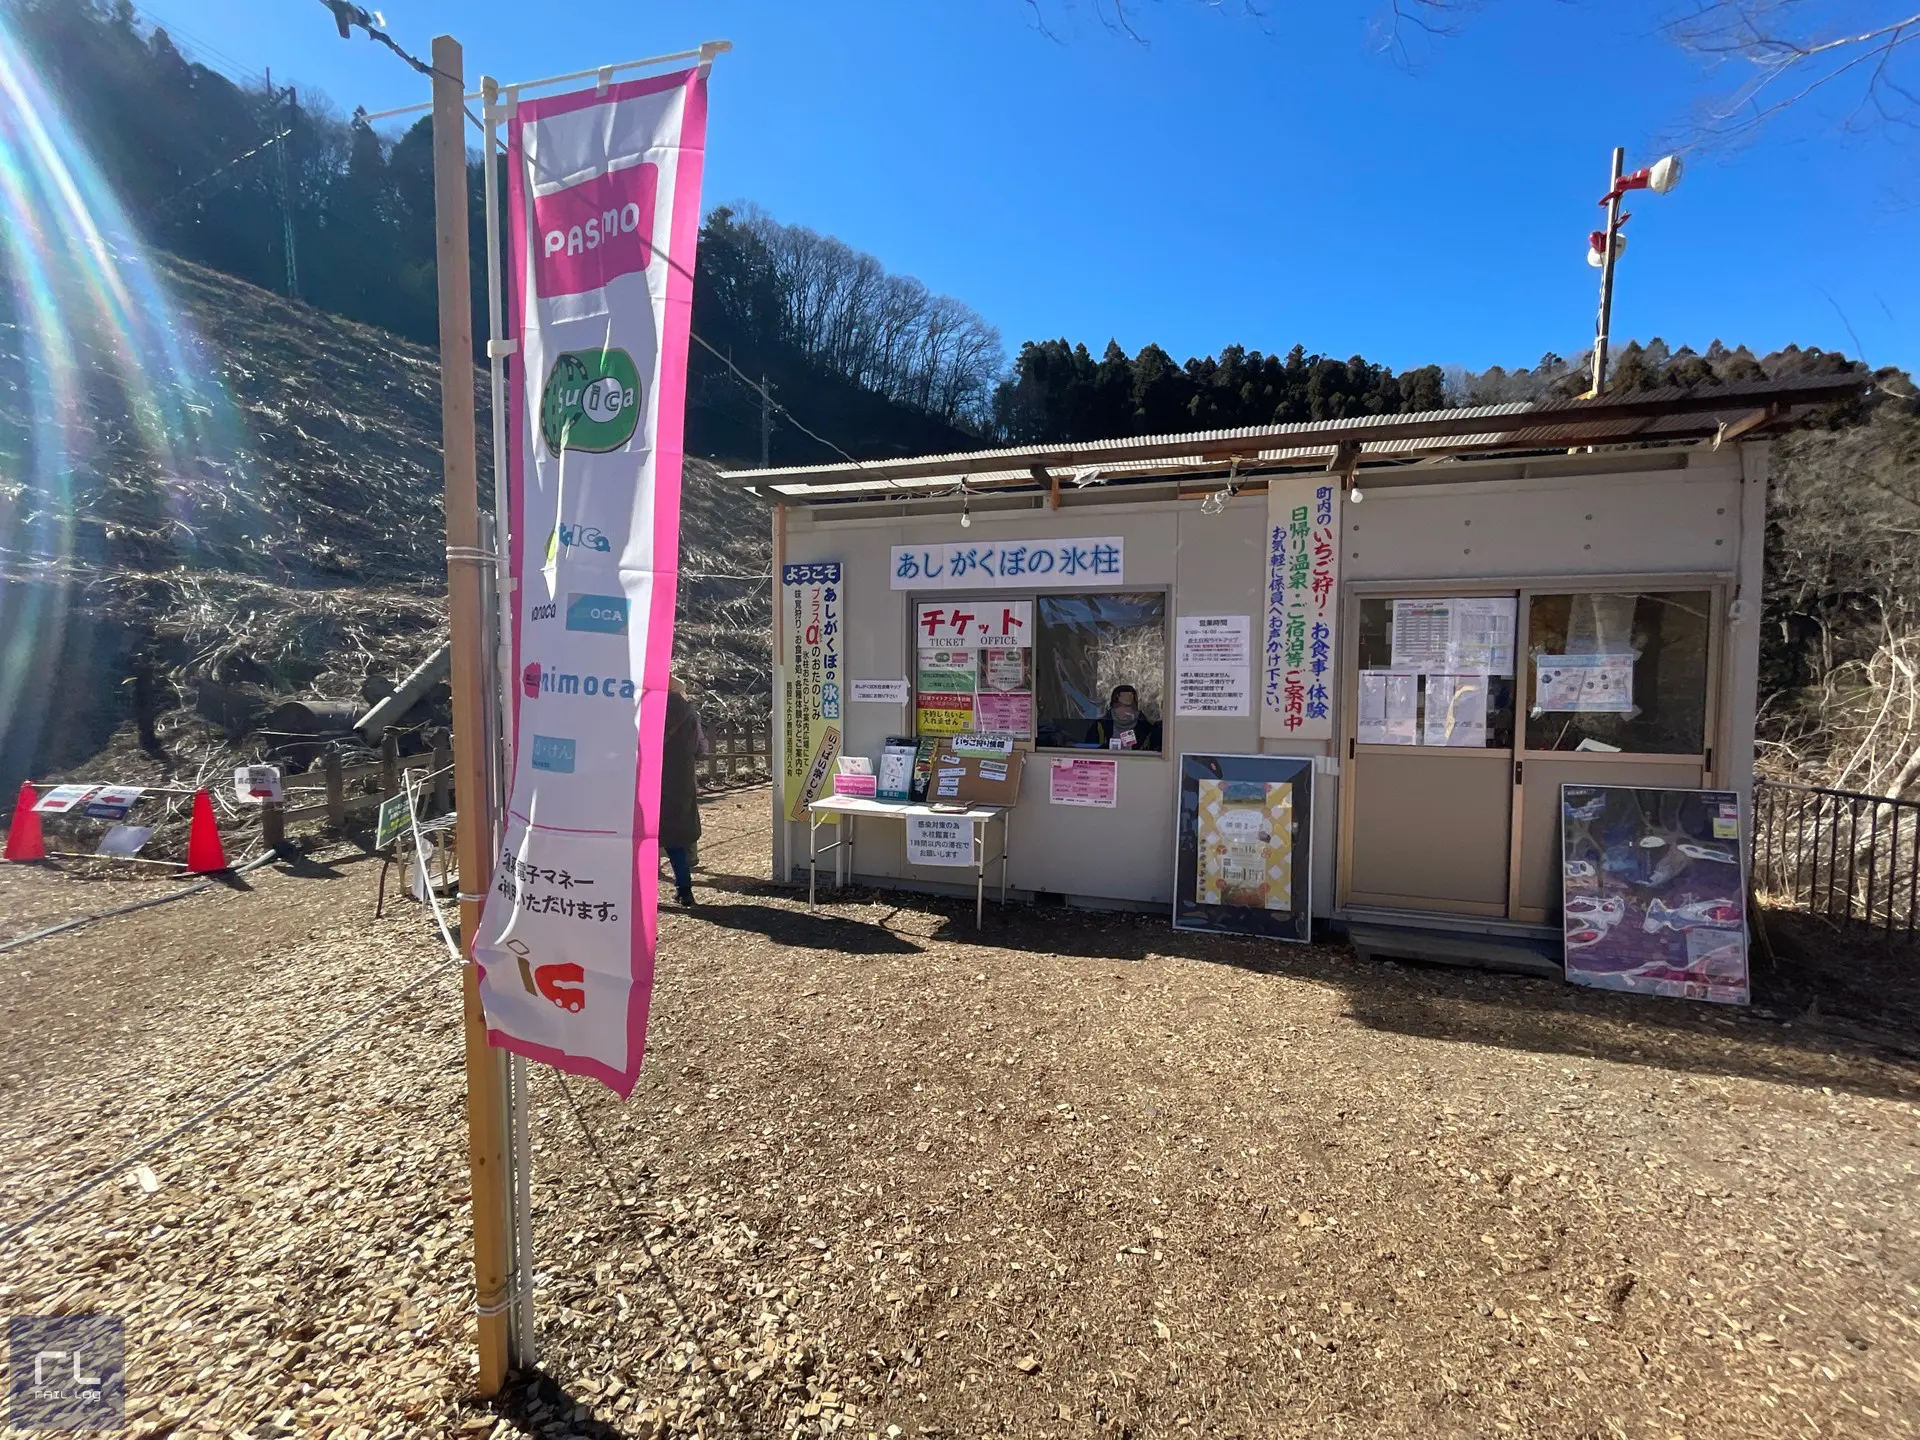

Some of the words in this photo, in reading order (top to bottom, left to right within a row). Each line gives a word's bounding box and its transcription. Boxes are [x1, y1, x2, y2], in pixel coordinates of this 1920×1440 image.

[545, 202, 640, 258] PASMO
[786, 565, 837, 580] ようこそ
[896, 543, 1119, 579] あしがくぼの氷柱
[1266, 526, 1287, 713] お気軽に係員へお声かけ下さい。
[1284, 505, 1311, 733] 日帰り温泉・ご宿泊等ご案内中
[1306, 486, 1334, 720] 町内のいちご狩り・お食事・体験
[920, 608, 1023, 636] チケット
[823, 587, 839, 718] あしがくぼの氷柱
[929, 638, 966, 647] TICKET
[980, 636, 1018, 646] OFFICE
[923, 718, 959, 726] 入れません
[920, 850, 959, 858] お願いします
